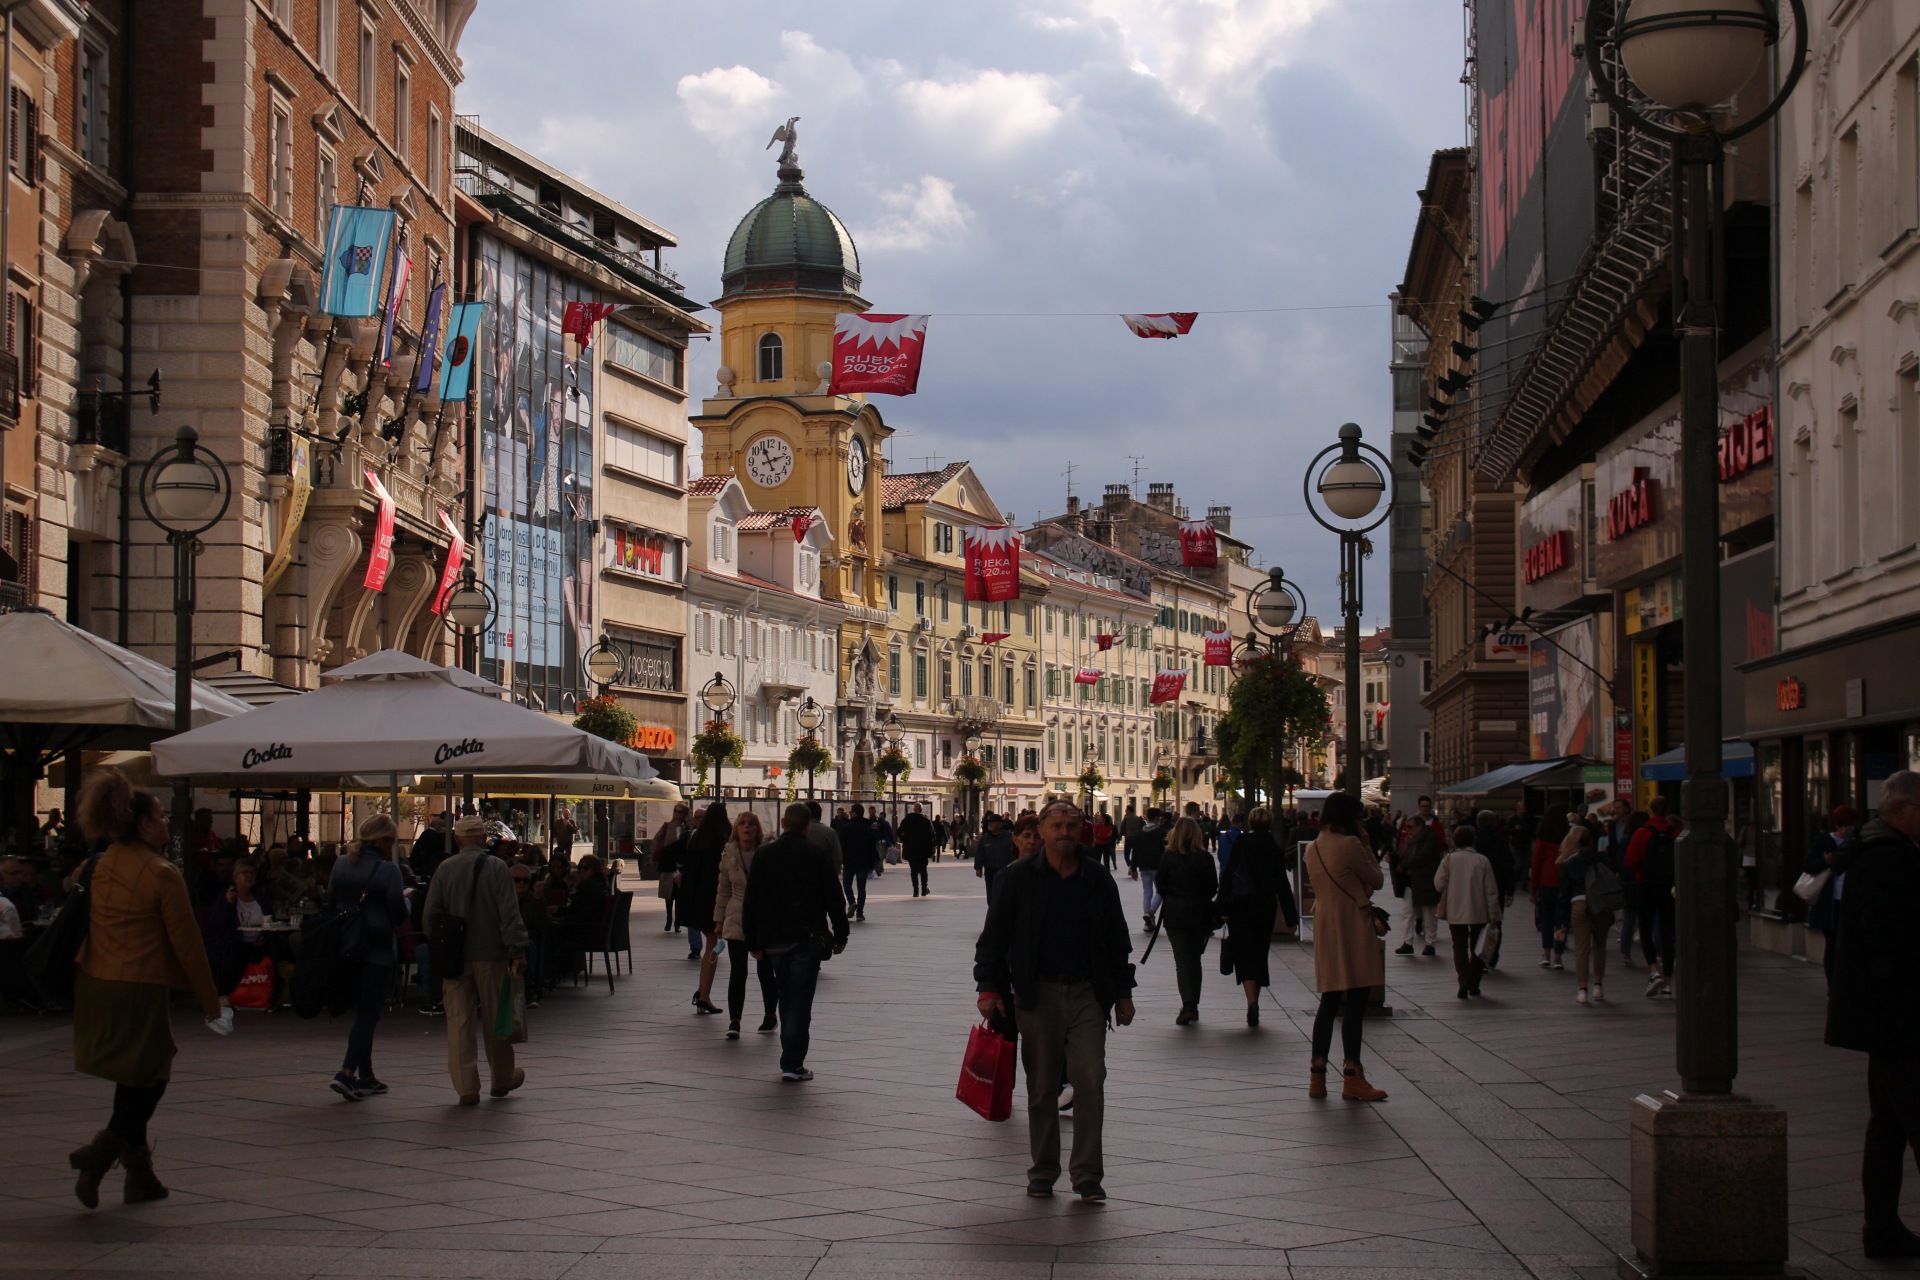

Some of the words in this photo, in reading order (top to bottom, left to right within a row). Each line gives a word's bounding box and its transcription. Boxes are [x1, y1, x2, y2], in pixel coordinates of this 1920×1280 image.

[842, 363, 908, 374] 2020.eu
[844, 353, 908, 365] RIJEKA
[1609, 467, 1650, 541] KUĆA
[616, 527, 664, 576] TOMMY
[974, 558, 1011, 568] RJEKA
[1524, 531, 1567, 585] ROBNA
[1498, 632, 1526, 645] dm
[1640, 648, 1649, 717] HAPPY
[242, 743, 293, 769] Cockta
[434, 738, 485, 765] Cockta
